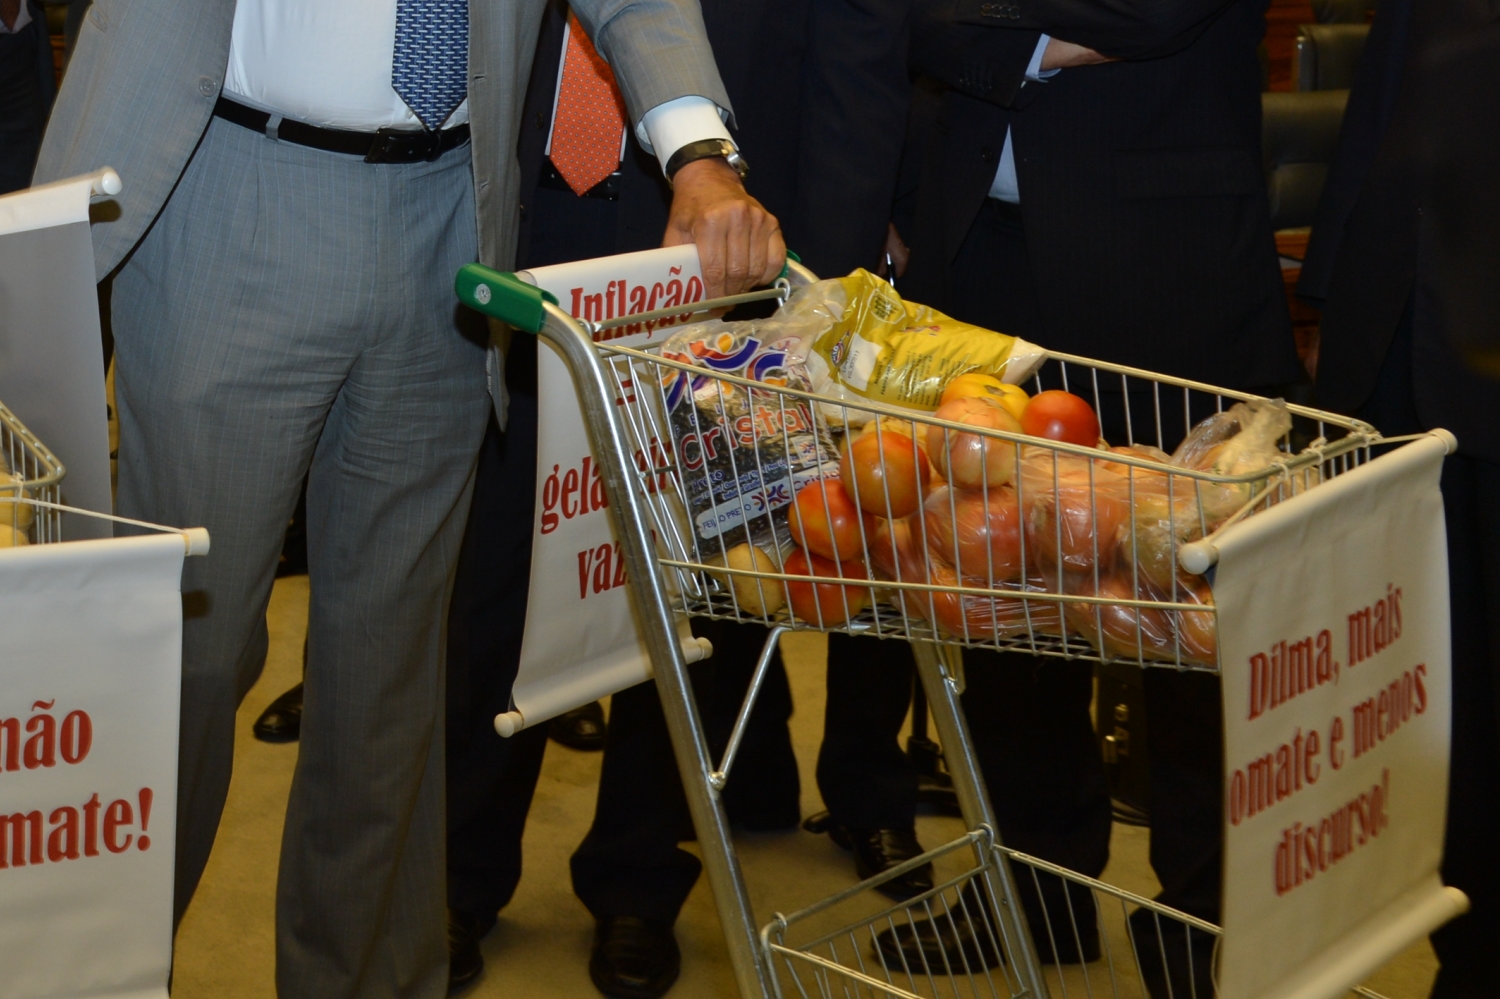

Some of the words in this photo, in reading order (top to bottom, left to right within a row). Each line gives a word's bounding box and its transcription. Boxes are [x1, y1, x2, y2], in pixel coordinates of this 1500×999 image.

[571, 265, 703, 342] Inflação
[702, 514, 726, 530] FEIJO
[726, 503, 752, 521] PREO
[1247, 630, 1340, 721] Dilma,
[1347, 581, 1403, 667] mais
[1229, 726, 1321, 826] omate
[1329, 716, 1345, 771] e
[1352, 663, 1428, 759] menos
[1274, 767, 1390, 897] discurso!
